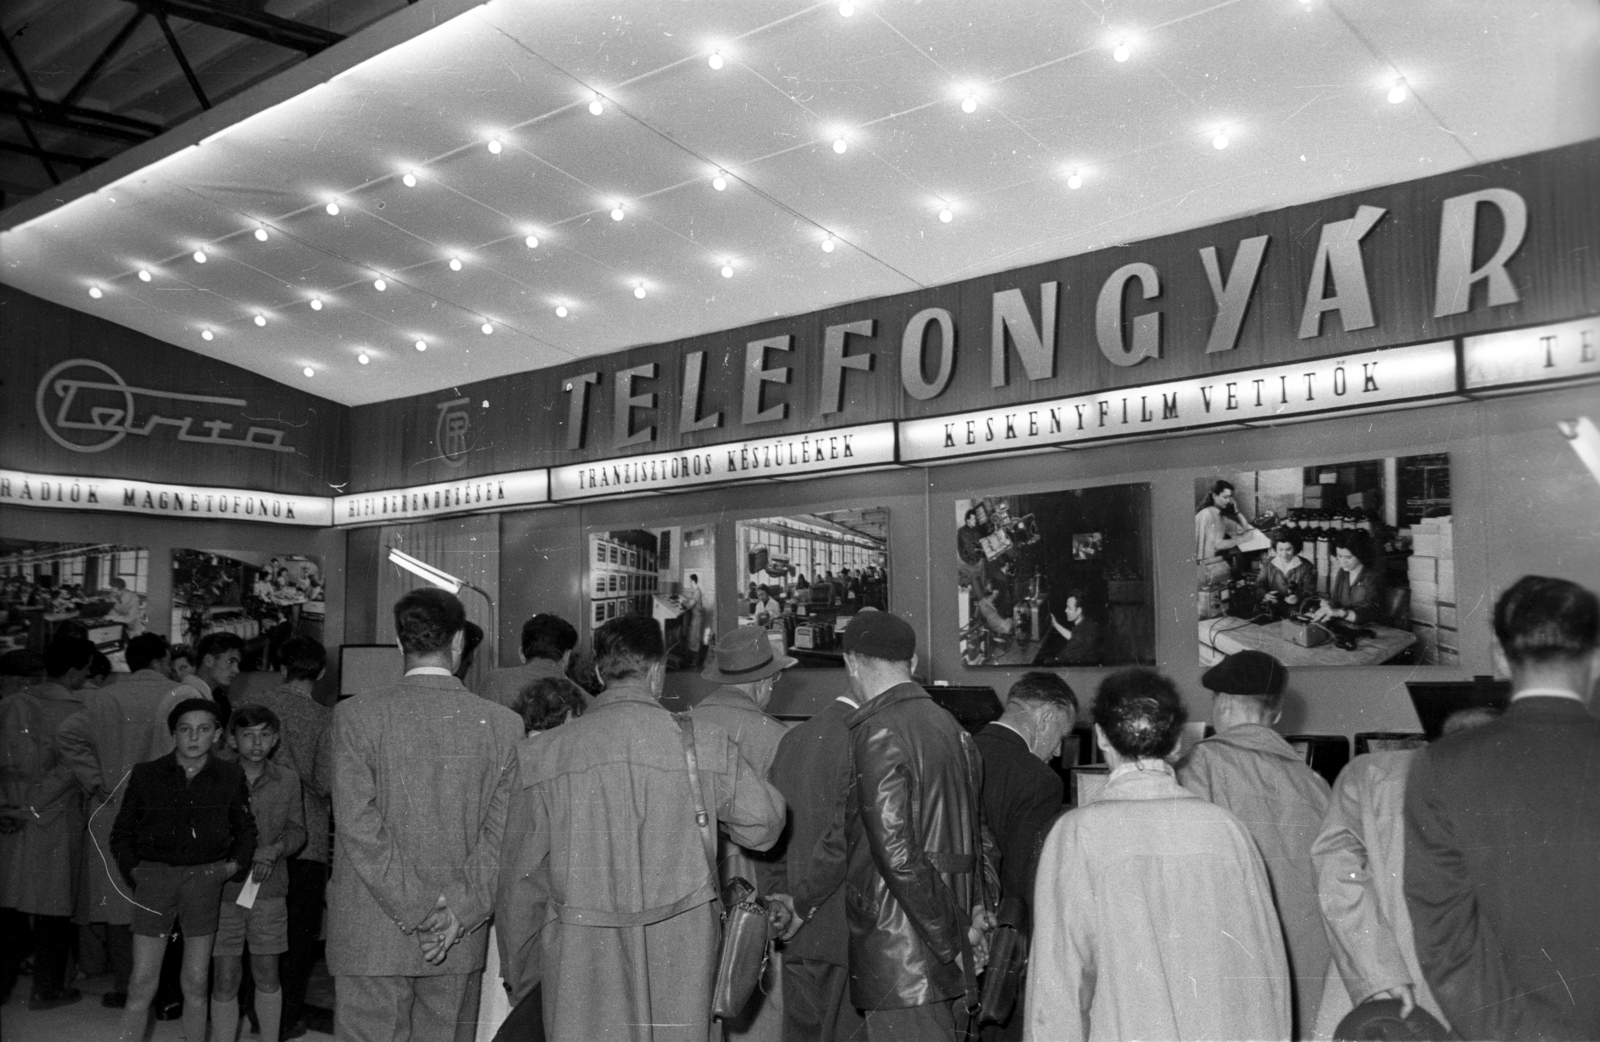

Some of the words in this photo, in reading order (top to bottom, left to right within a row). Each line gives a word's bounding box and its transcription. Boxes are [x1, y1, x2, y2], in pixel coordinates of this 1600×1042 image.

[561, 187, 1528, 452] TELEFONGYÁR
[943, 391, 1179, 448] KESKENYFILM
[578, 453, 712, 490] TRANZISZTOROS
[727, 434, 854, 473] KÉSZÜLÉKEK
[122, 487, 296, 519] MAGNETOFONOK
